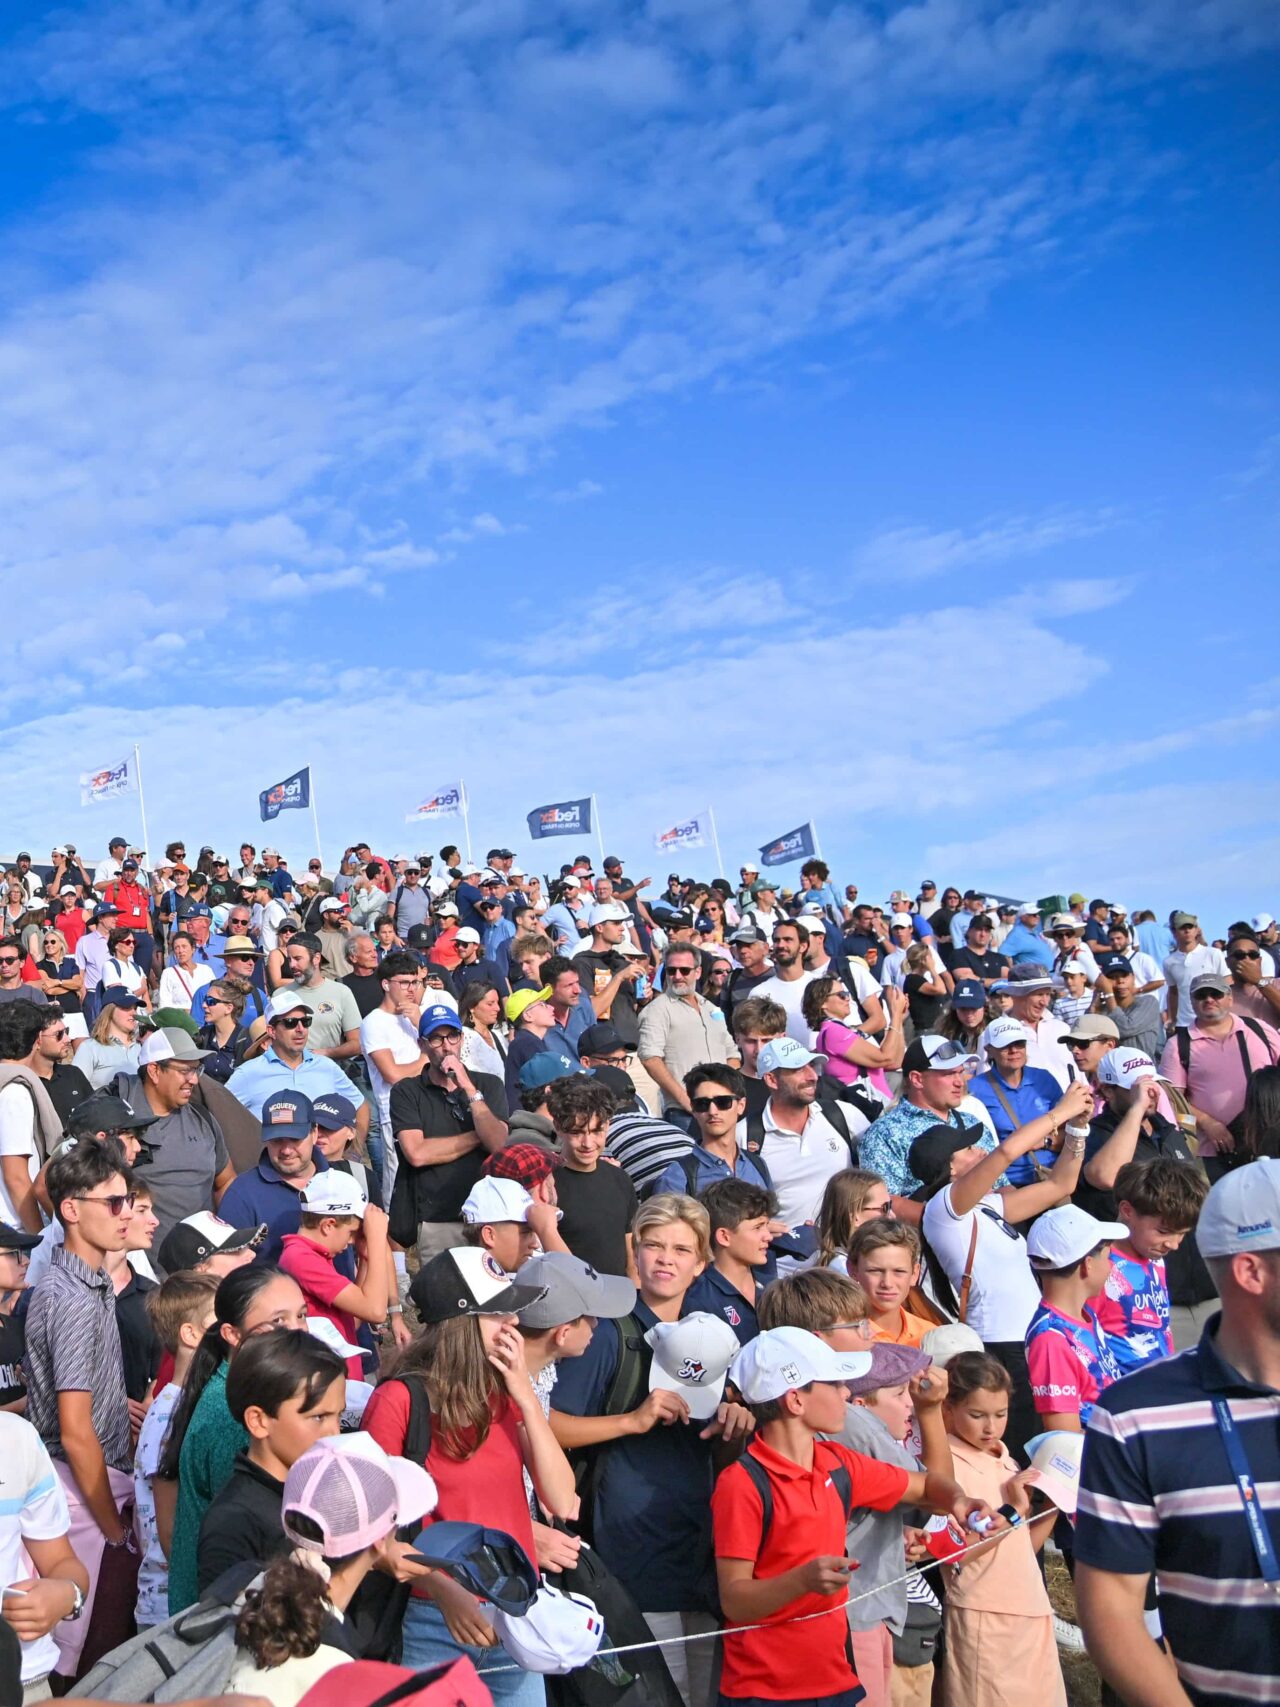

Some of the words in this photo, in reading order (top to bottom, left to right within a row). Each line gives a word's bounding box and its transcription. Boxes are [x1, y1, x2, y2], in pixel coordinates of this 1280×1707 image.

[269, 1103, 297, 1112] MCQUEEN
[327, 1203, 352, 1211] TP5
[1237, 1220, 1272, 1233] Amundi
[1135, 1280, 1168, 1310] enfan
[1238, 1475, 1253, 1500] FedEx
